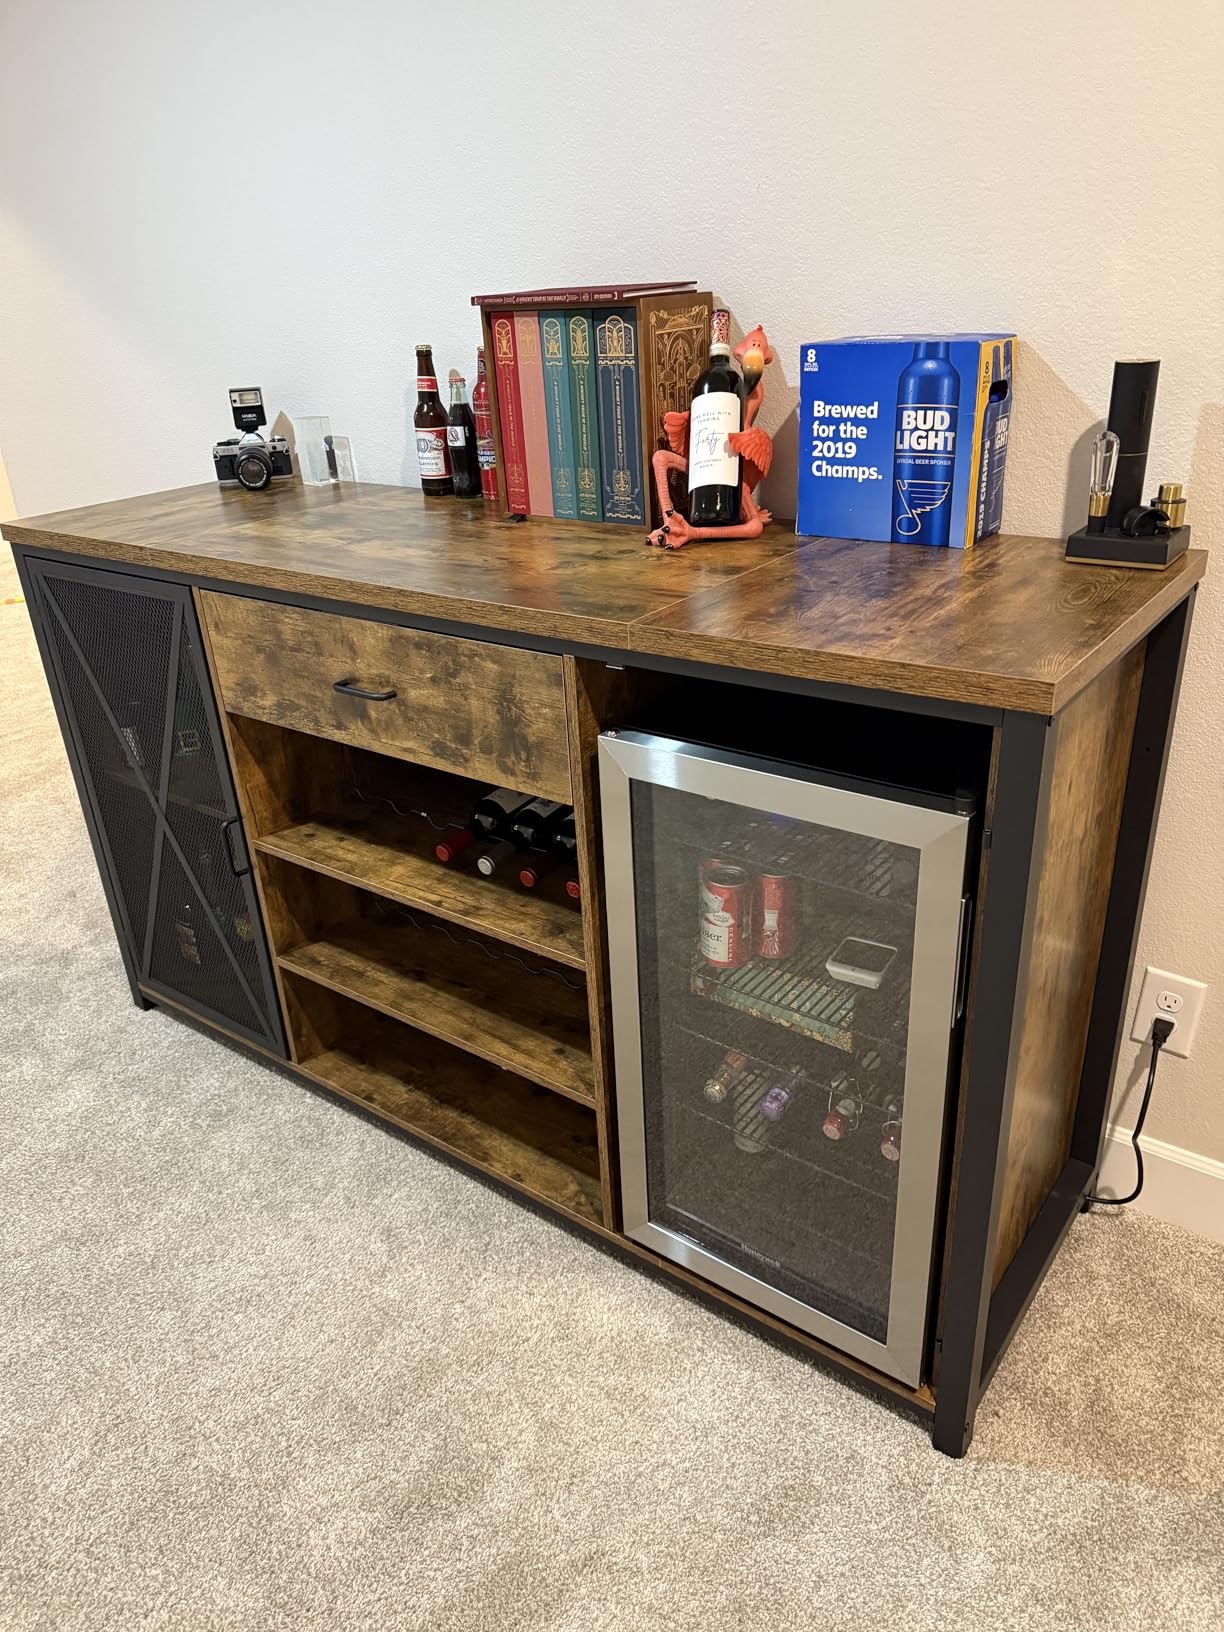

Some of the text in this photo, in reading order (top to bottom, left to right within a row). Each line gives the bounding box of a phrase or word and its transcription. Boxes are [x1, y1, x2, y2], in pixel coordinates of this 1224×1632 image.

[807, 349, 816, 362] 8
[813, 400, 879, 419] Brewed
[812, 420, 868, 439] for the
[902, 410, 950, 430] BUD
[812, 440, 857, 459] 2019
[896, 430, 956, 451] LIGHT
[811, 460, 883, 483] Champs.
[977, 440, 991, 538] 2019 CHAMPS
